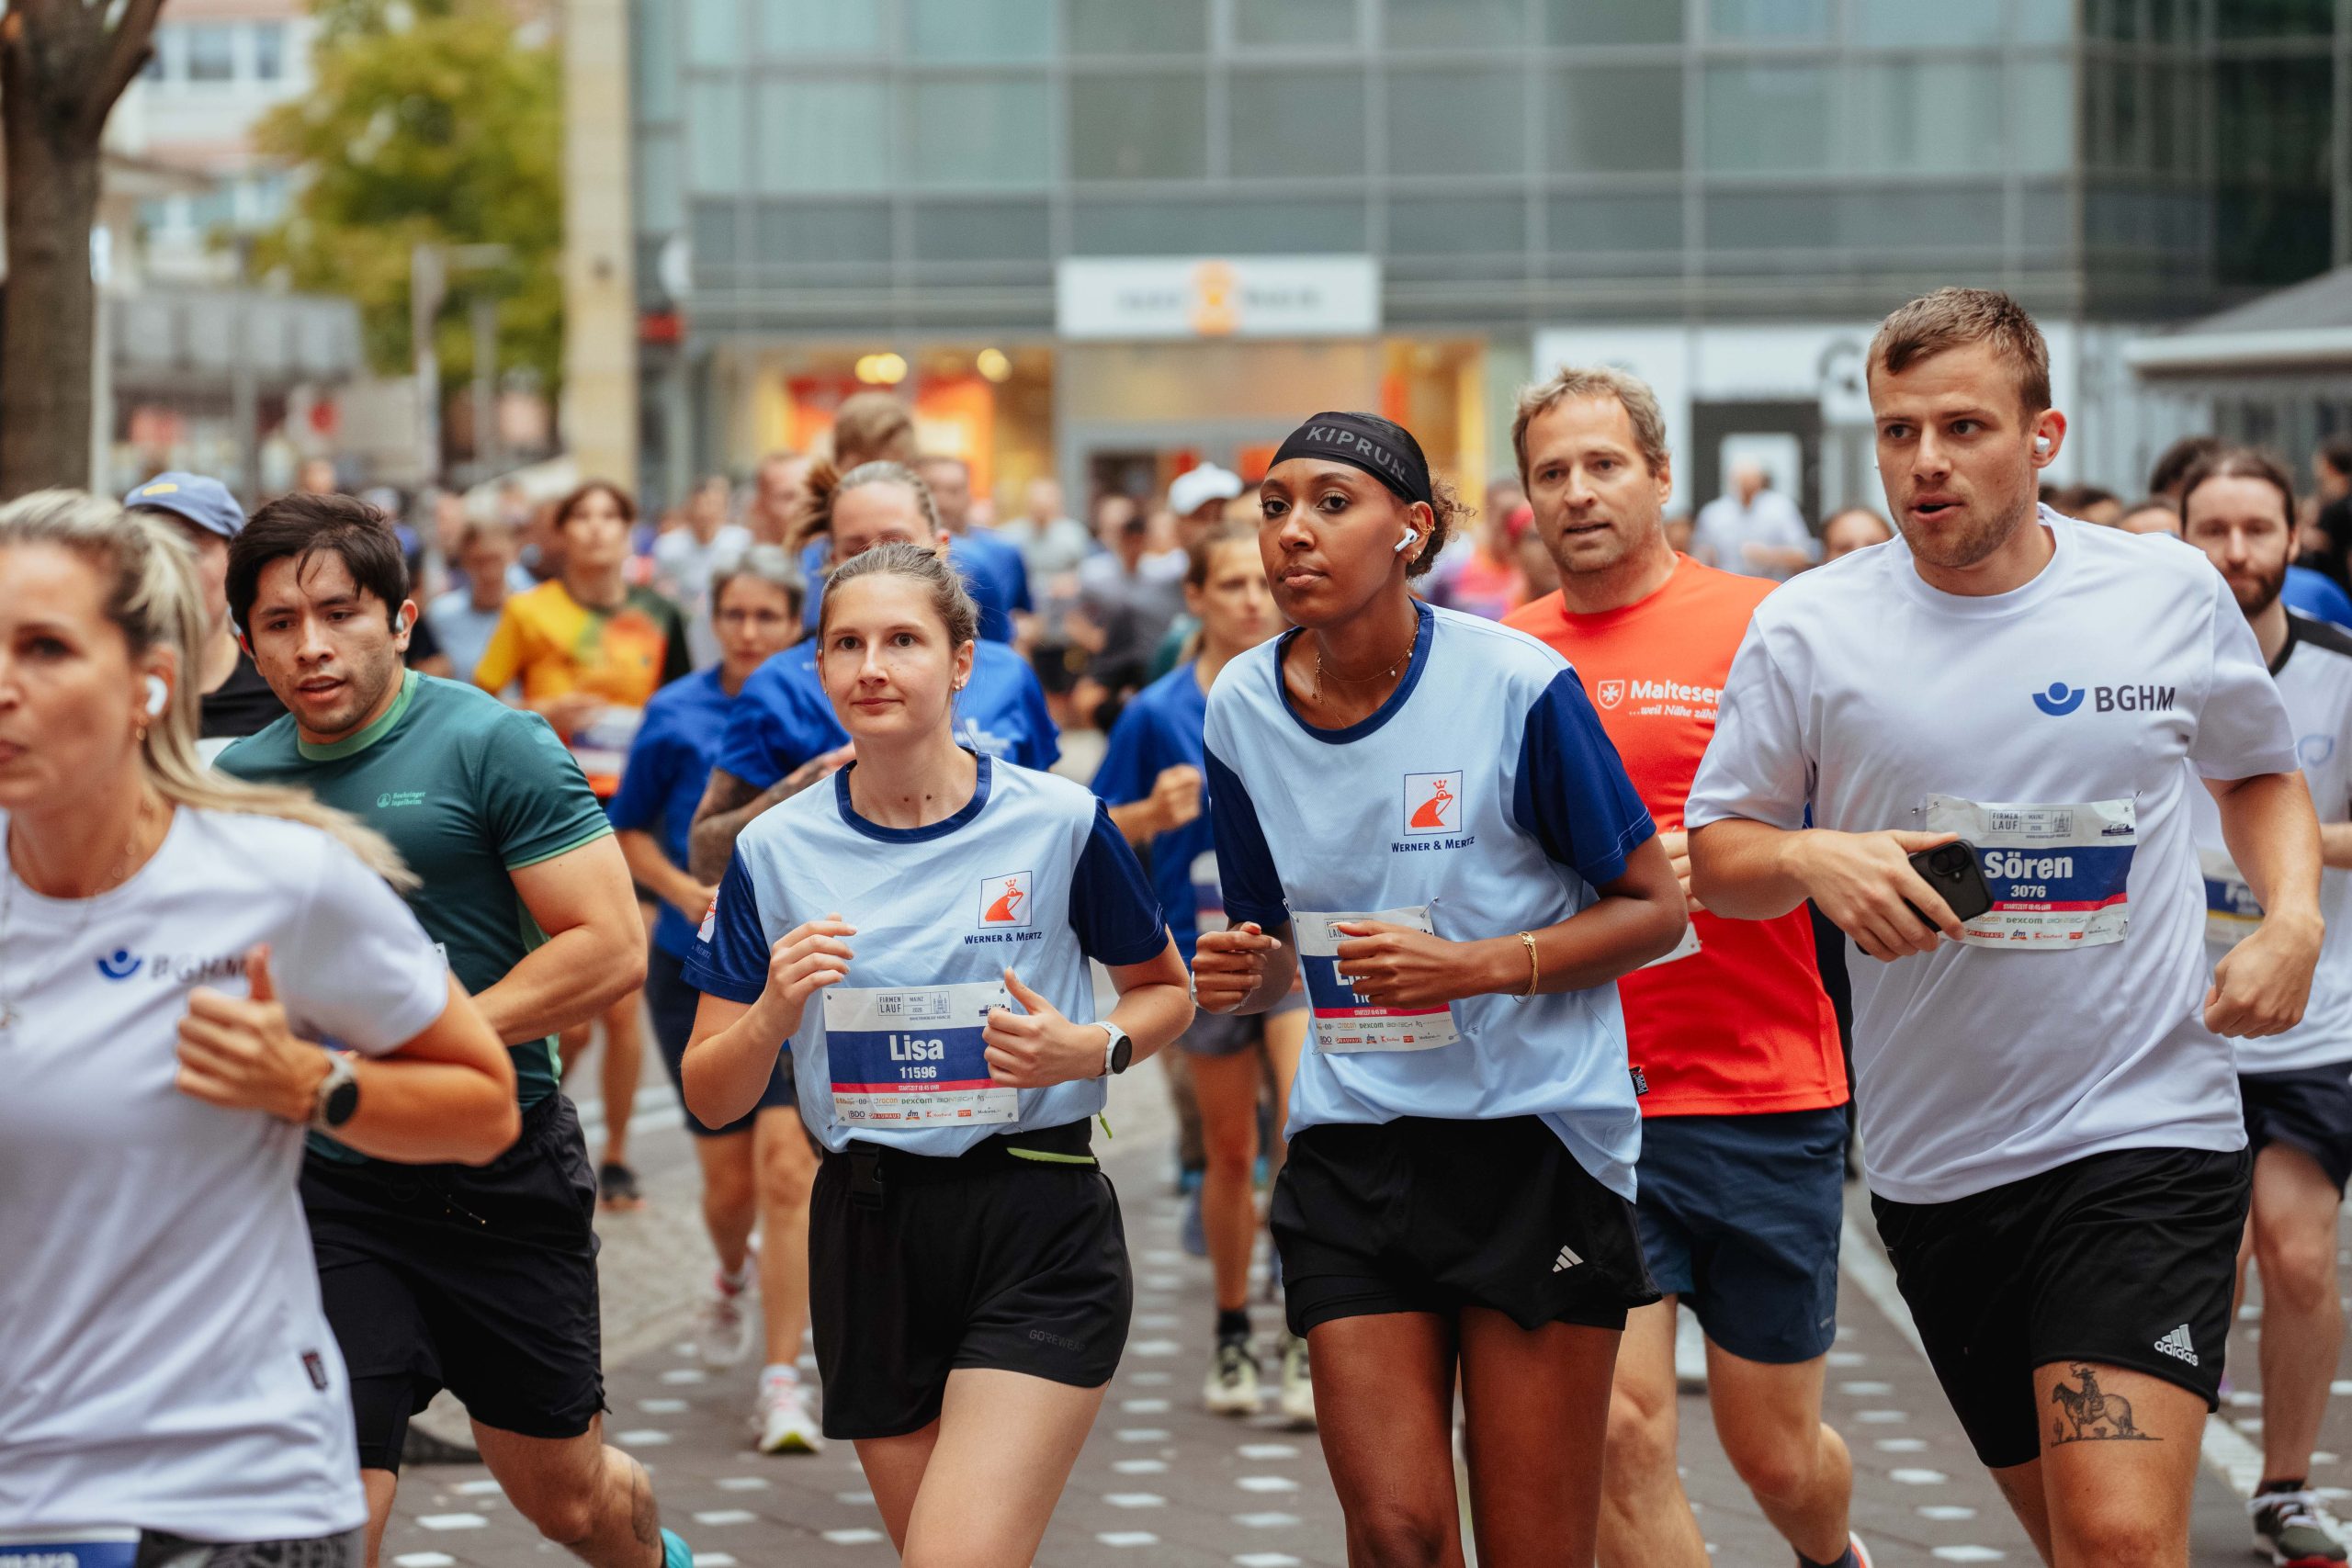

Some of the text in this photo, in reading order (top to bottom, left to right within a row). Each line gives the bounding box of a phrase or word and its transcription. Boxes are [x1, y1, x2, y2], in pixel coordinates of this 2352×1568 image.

[1306, 426, 1407, 481] KIPRUN
[1630, 679, 1724, 705] Malteser
[2094, 684, 2176, 713] BGHM
[1664, 705, 1692, 717] Nähe
[1992, 820, 2018, 830] LAUF
[1433, 840, 1442, 851] &
[1984, 851, 2074, 880] Sören
[2009, 885, 2047, 898] 3076
[1005, 932, 1013, 942] &
[879, 1004, 901, 1013] LAUF
[888, 1034, 944, 1061] Lisa
[899, 1066, 937, 1079] 11596
[849, 1110, 865, 1118] BDO
[2154, 1340, 2199, 1367] adidas
